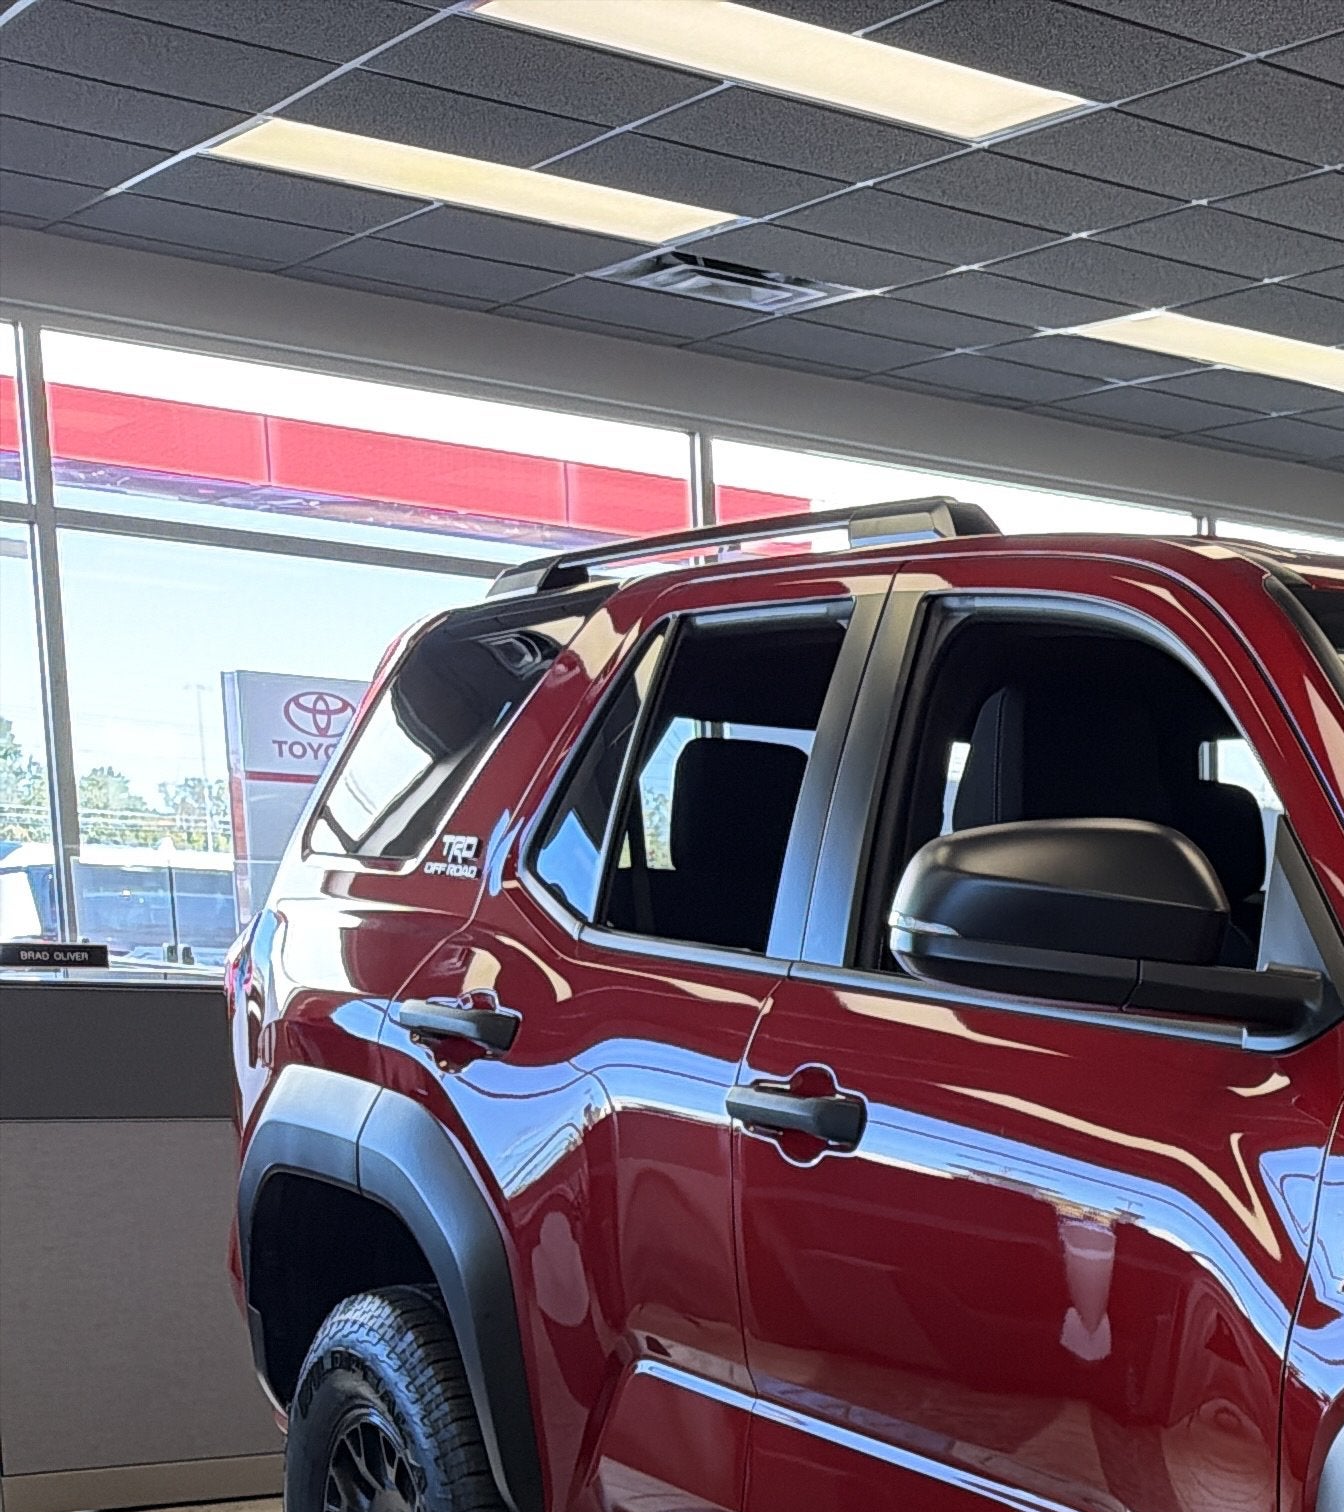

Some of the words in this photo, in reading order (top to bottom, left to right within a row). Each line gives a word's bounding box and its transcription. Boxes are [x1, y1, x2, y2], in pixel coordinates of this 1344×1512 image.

[272, 739, 338, 761] TOY
[443, 834, 479, 864] TRD
[424, 862, 447, 875] OFF
[446, 864, 478, 879] ROAD
[20, 950, 50, 961] BRAD
[53, 951, 89, 962] OLIVER
